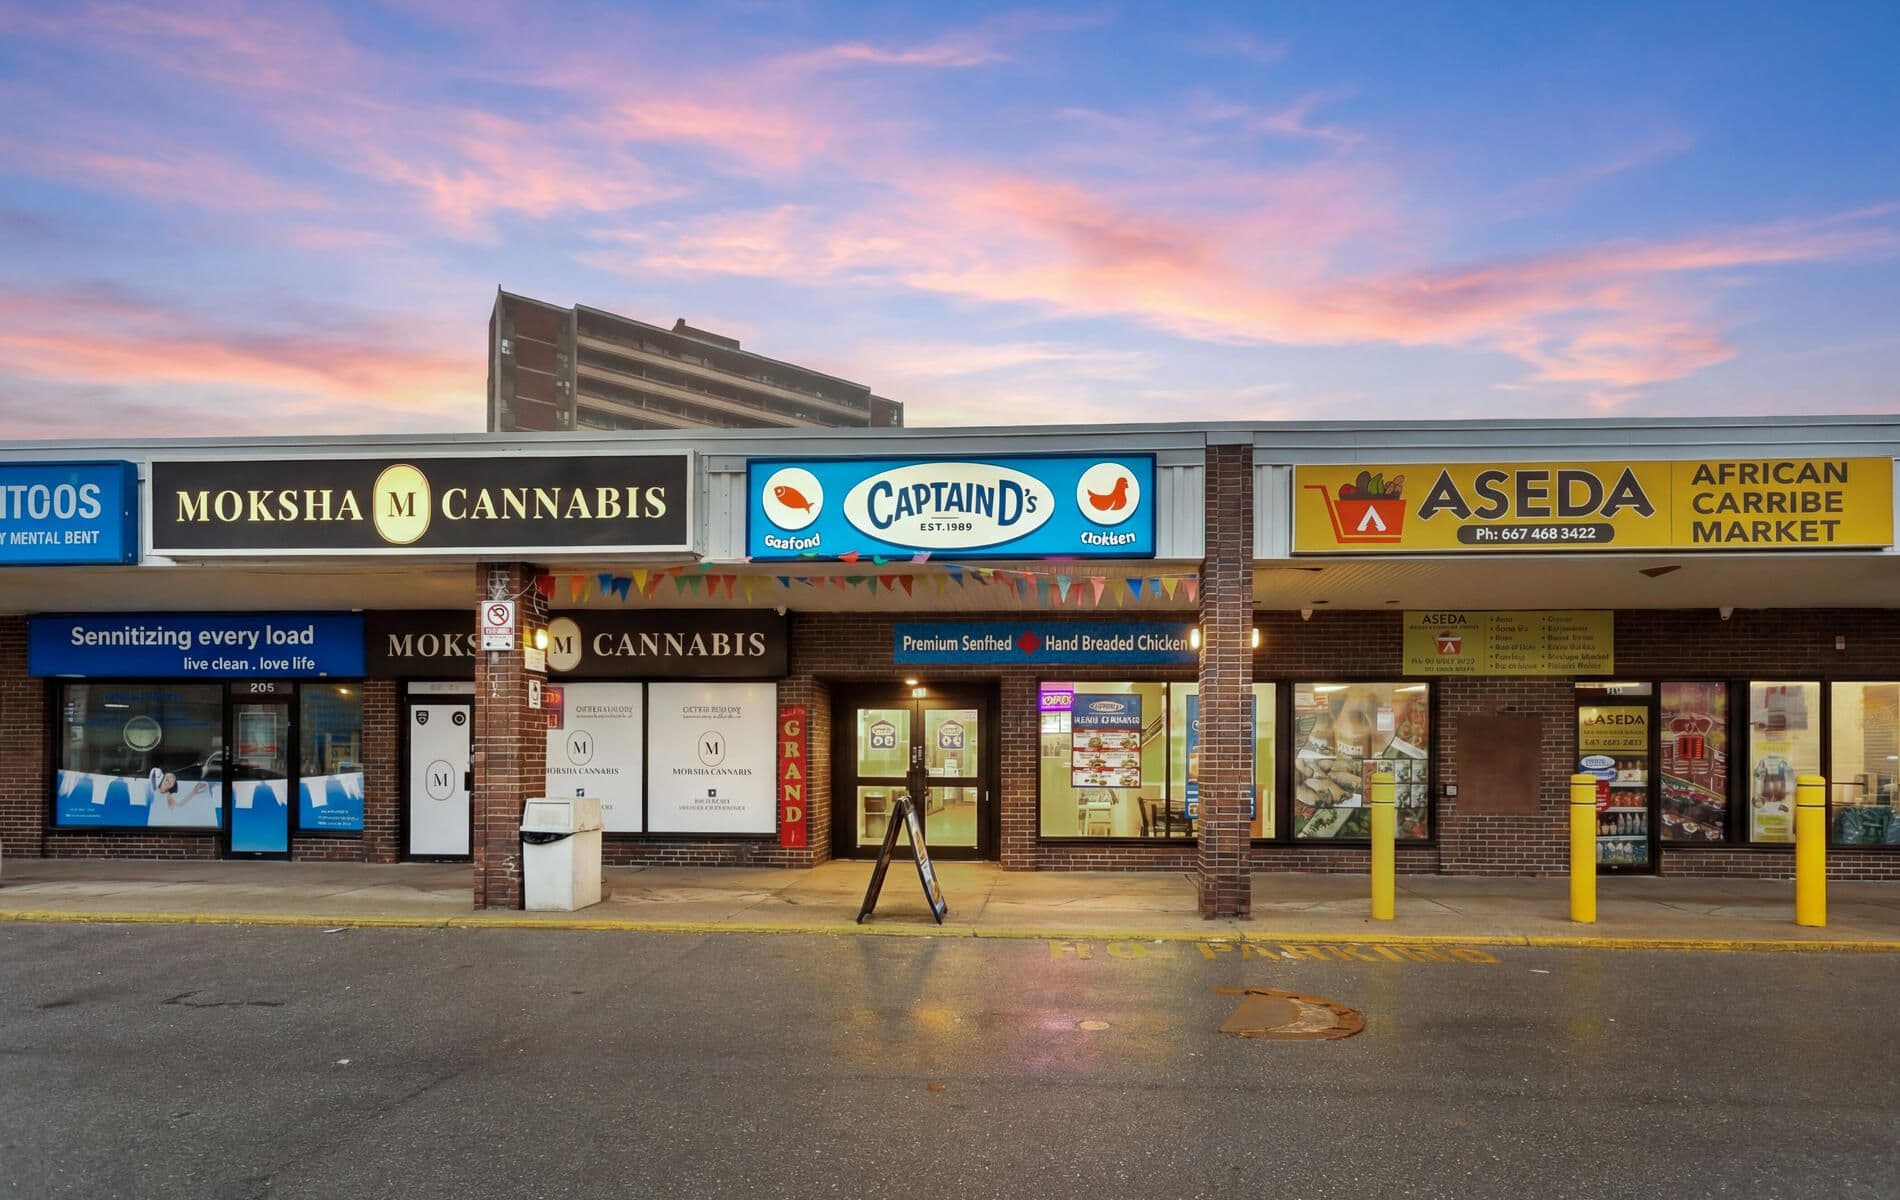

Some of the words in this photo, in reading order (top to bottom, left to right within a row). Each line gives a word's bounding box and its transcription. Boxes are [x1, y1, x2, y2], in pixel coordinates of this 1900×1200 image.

[1691, 462, 1848, 485] AFRICAN
[1416, 465, 1656, 521] ASEDA
[176, 489, 363, 522] MOKSHA
[387, 491, 416, 518] M
[441, 486, 667, 520] CANNABIS
[1692, 491, 1844, 514] CARRIBE
[10, 531, 61, 545] MENTAL
[64, 530, 100, 544] BENT
[1475, 527, 1498, 540] Ph:
[1501, 527, 1528, 540] 667
[1531, 527, 1558, 540] 468
[1561, 527, 1596, 540] 3422
[1693, 520, 1841, 543] MARKET
[1422, 613, 1468, 625] ASEDA
[71, 626, 192, 650] Sennitizing
[198, 629, 260, 650] every
[266, 625, 314, 645] load
[553, 636, 573, 655] M
[593, 632, 766, 657] CANNABIS
[903, 635, 958, 651] Premium
[1045, 635, 1078, 651] Hand
[1082, 635, 1133, 651] Breaded
[1137, 634, 1188, 651] Chicken
[183, 656, 208, 670] live
[211, 656, 248, 670] clean
[260, 656, 289, 670] love
[292, 656, 315, 670] life
[250, 682, 274, 693] 205
[1595, 714, 1645, 725] ASEDA
[573, 741, 586, 754] M
[706, 741, 719, 755] M
[784, 720, 802, 823] GRAND
[434, 773, 447, 787] M
